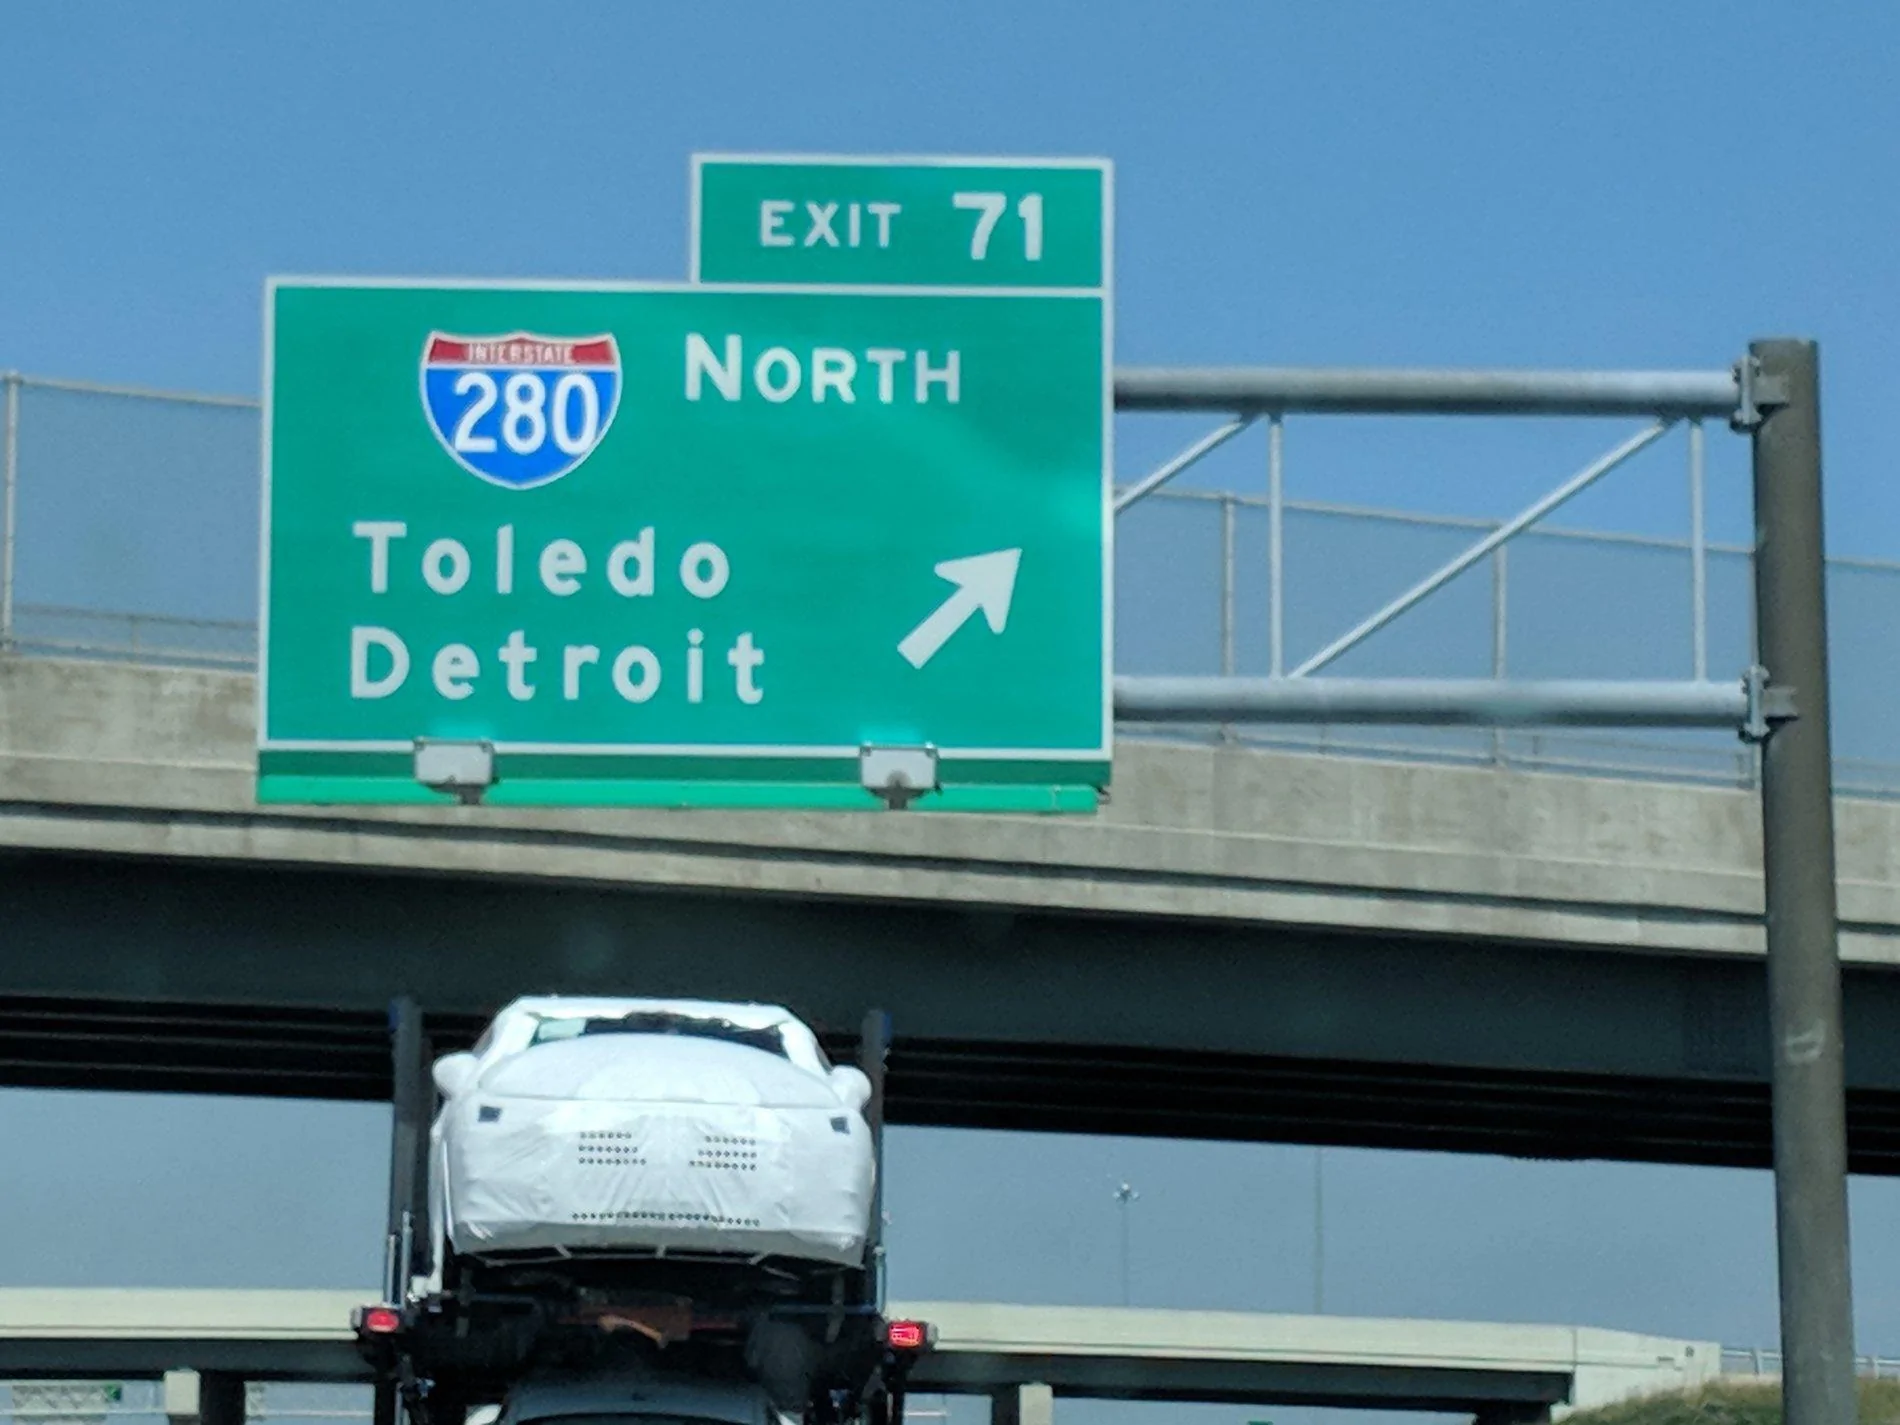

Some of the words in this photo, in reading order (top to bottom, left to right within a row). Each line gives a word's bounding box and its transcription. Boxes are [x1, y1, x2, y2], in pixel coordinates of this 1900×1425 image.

[761, 200, 900, 246] EXIT
[953, 192, 1043, 260] 71
[467, 341, 573, 365] INTERSTATE
[685, 332, 961, 403] NORTH
[453, 371, 600, 456] 280
[352, 521, 730, 598] Toledo
[350, 626, 765, 704] Detroit
